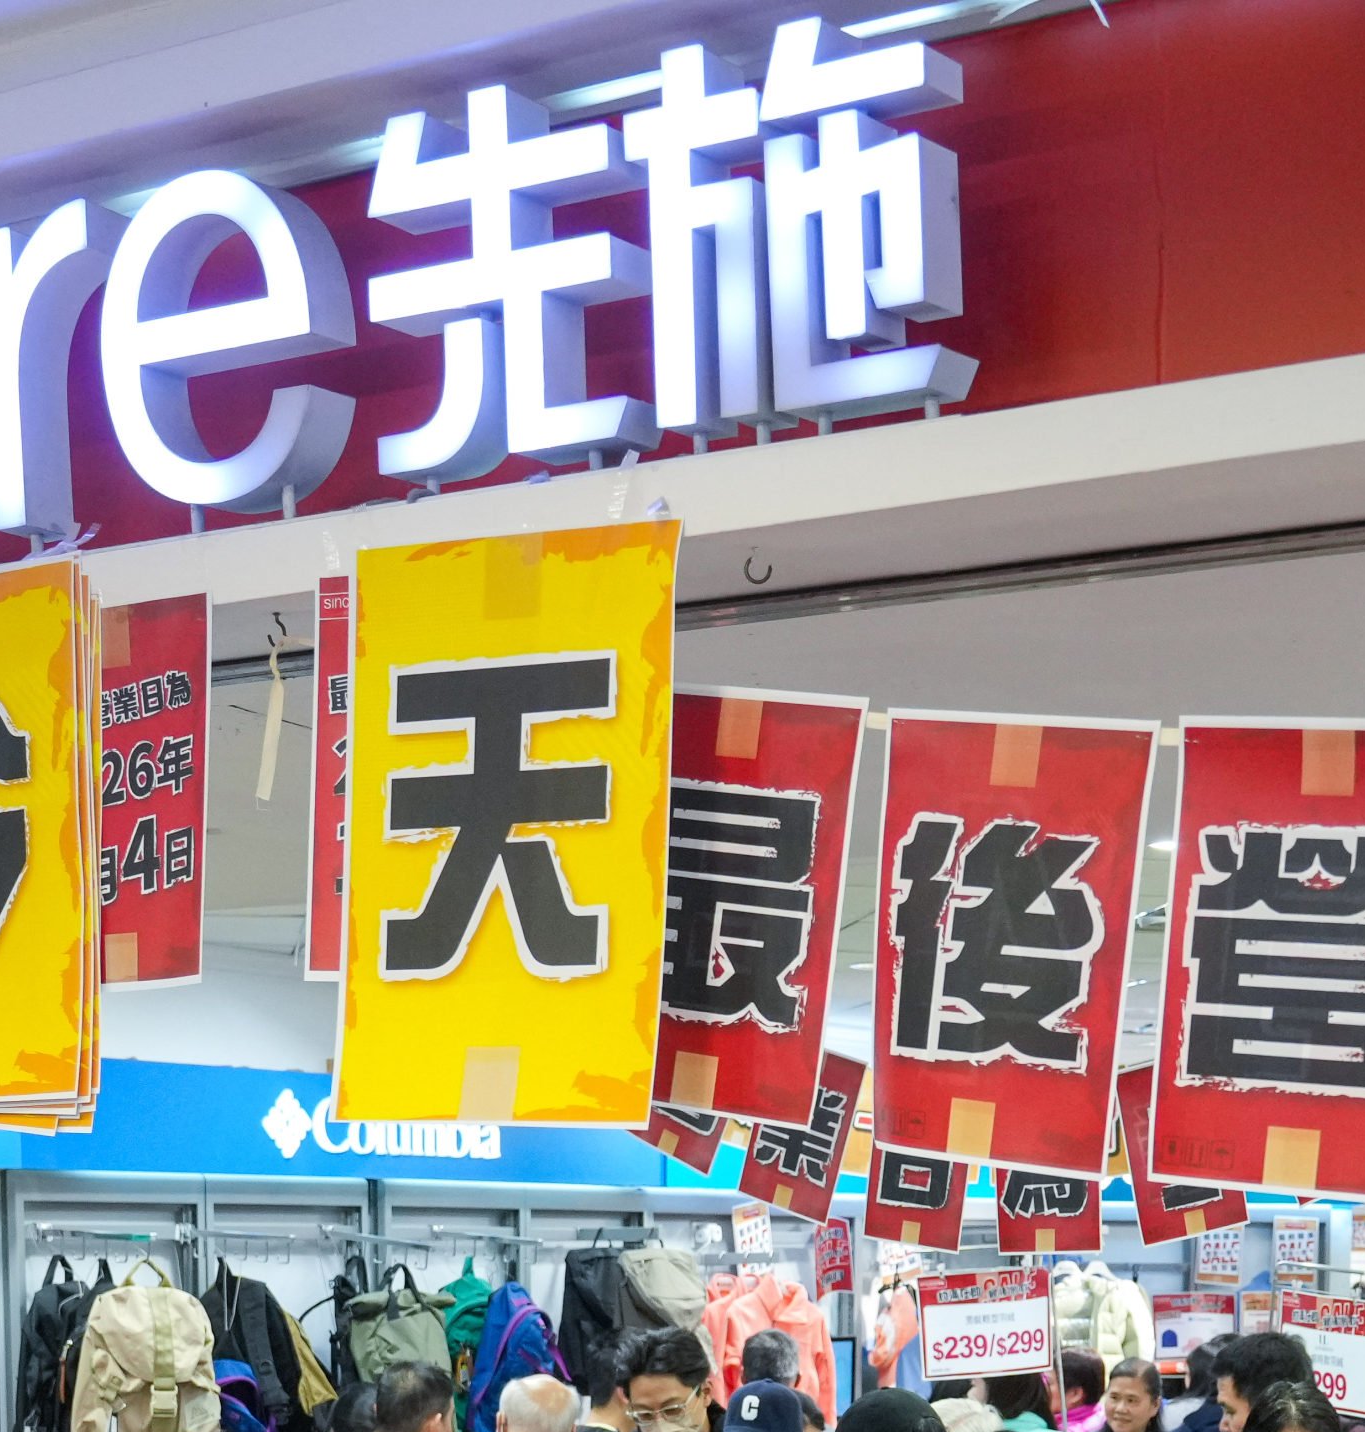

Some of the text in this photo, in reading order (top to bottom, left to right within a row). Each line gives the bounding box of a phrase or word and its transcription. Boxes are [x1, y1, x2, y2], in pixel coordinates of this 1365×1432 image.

[365, 15, 975, 482] 先施
[932, 1328, 1045, 1362] $239/$299
[741, 1395, 761, 1421] C
